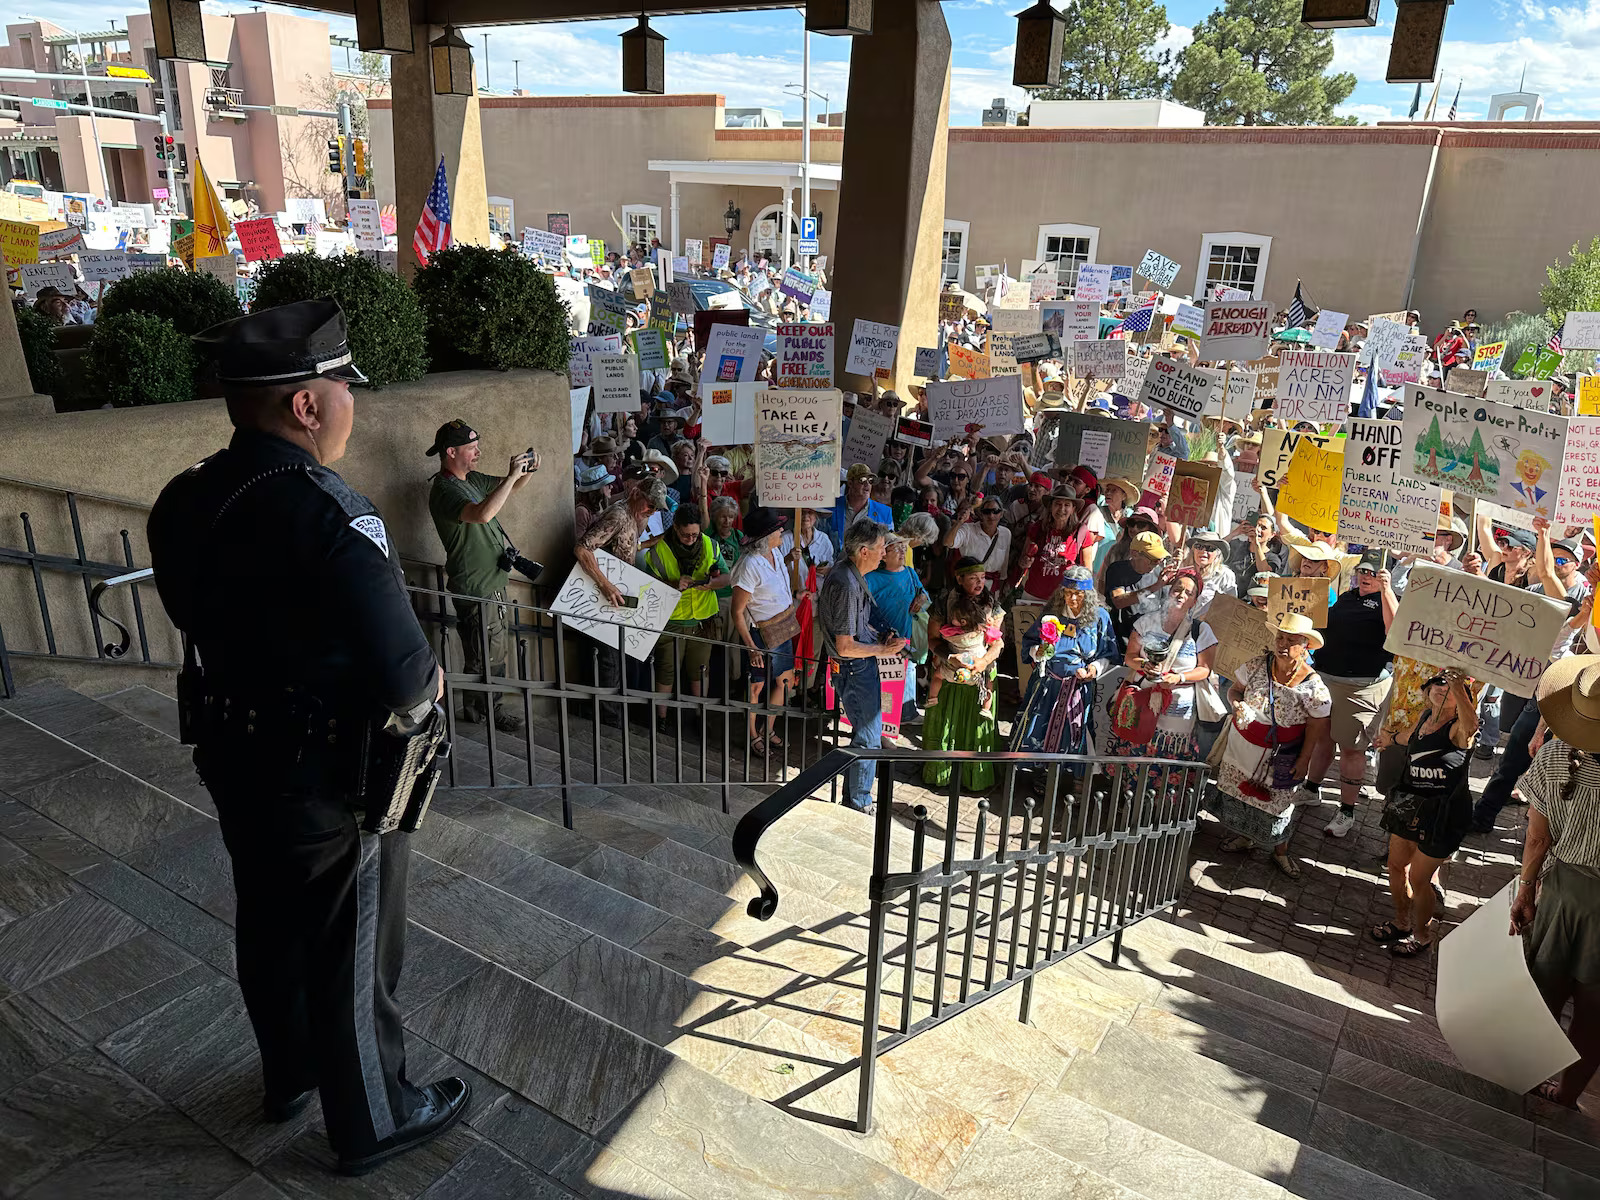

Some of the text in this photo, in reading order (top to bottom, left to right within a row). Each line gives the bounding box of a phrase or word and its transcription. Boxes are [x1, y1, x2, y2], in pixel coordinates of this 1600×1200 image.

[5, 222, 38, 237] MEXICO
[805, 221, 815, 235] P
[10, 235, 36, 249] LANDS
[260, 236, 271, 244] OUR
[80, 254, 125, 263] THIS LAND
[1149, 251, 1178, 272] SAVE
[25, 265, 61, 277] LEAVE IT
[111, 266, 127, 274] LAND
[1081, 264, 1110, 274] Wilderness
[1112, 266, 1131, 279] SAVE
[1140, 262, 1172, 281] CULTURAL
[1138, 270, 1169, 287] TREASURES
[30, 281, 41, 290] AS
[590, 287, 625, 304] LOSE
[602, 302, 627, 315] WILD
[1210, 307, 1267, 320] ENOUGH
[589, 304, 625, 328] LOSE
[1395, 312, 1406, 322] OFF
[650, 318, 675, 334] PUBLIC
[777, 325, 834, 336] KEEP OUR
[856, 320, 899, 338] THE EL RITO
[1206, 321, 1269, 340] ALREADY!
[1382, 321, 1400, 332] OUR
[716, 329, 759, 341] public lands
[1374, 334, 1394, 347] MAKE
[603, 342, 616, 351] do
[784, 337, 827, 350] PUBLIC
[854, 335, 894, 349] WATERSHED
[1089, 342, 1111, 352] KEEP
[722, 347, 746, 355] PEOPLE
[870, 349, 887, 358] NOT
[919, 350, 936, 359] NO
[1411, 345, 1423, 353] ARE
[1477, 345, 1502, 358] STOP
[783, 351, 824, 363] LANDS
[853, 356, 887, 368] FOR SALE
[1077, 351, 1124, 362] PUBLIC LANDS
[782, 363, 807, 376] FREE
[1078, 364, 1102, 375] PUBLIC
[1126, 357, 1150, 371] GOP:
[1475, 359, 1501, 369] PUBLIC
[1155, 361, 1208, 388] GOP LAND
[1261, 374, 1270, 384] is
[1286, 369, 1344, 385] ACRES
[1382, 368, 1403, 384] Piggy
[778, 376, 831, 389] GENERATIONS
[1157, 374, 1195, 397] STEAL
[1226, 384, 1250, 394] NOT
[1117, 385, 1134, 396] OUR
[1288, 382, 1344, 401] IN NM
[1499, 386, 1530, 400] If you
[762, 394, 818, 406] Hey, DOUG
[1149, 383, 1203, 414] NO BUENO
[1277, 398, 1345, 421] FOR SALE
[1525, 400, 1545, 412] Parks
[762, 409, 816, 420] TAKE A
[934, 406, 1010, 421] ARE PARASITES
[1414, 390, 1561, 441] People Over Profit
[783, 421, 829, 437] HIKE!
[1569, 425, 1586, 435] NOT
[1361, 445, 1402, 469] OFF
[764, 472, 820, 481] SEE WHY
[1302, 468, 1330, 489] NOT
[1345, 468, 1381, 484] PUBLIC
[1390, 473, 1427, 492] LANDS
[1568, 477, 1581, 487] ITS
[765, 482, 781, 490] WE
[762, 492, 825, 502] Public Lands
[1342, 483, 1389, 502] VETERAN
[1396, 490, 1438, 513] SERVICES
[1342, 496, 1399, 515] EDUCATION
[1310, 501, 1339, 526] Sale
[1342, 508, 1361, 518] OUR
[1364, 511, 1400, 529] RIGHTS
[355, 518, 383, 530] STATE
[1339, 518, 1364, 532] SOCIAL
[1368, 522, 1409, 543] SECURITY
[1337, 532, 1429, 555] PROTECT OUR CONSTITUTION
[1043, 567, 1060, 577] 1776
[1411, 576, 1433, 589] ALL
[1281, 583, 1310, 600] NOT
[1286, 602, 1306, 614] FOR
[1433, 578, 1536, 629] HANDS
[1456, 611, 1497, 636] OFF
[1407, 620, 1542, 681] PUBLIC LAND
